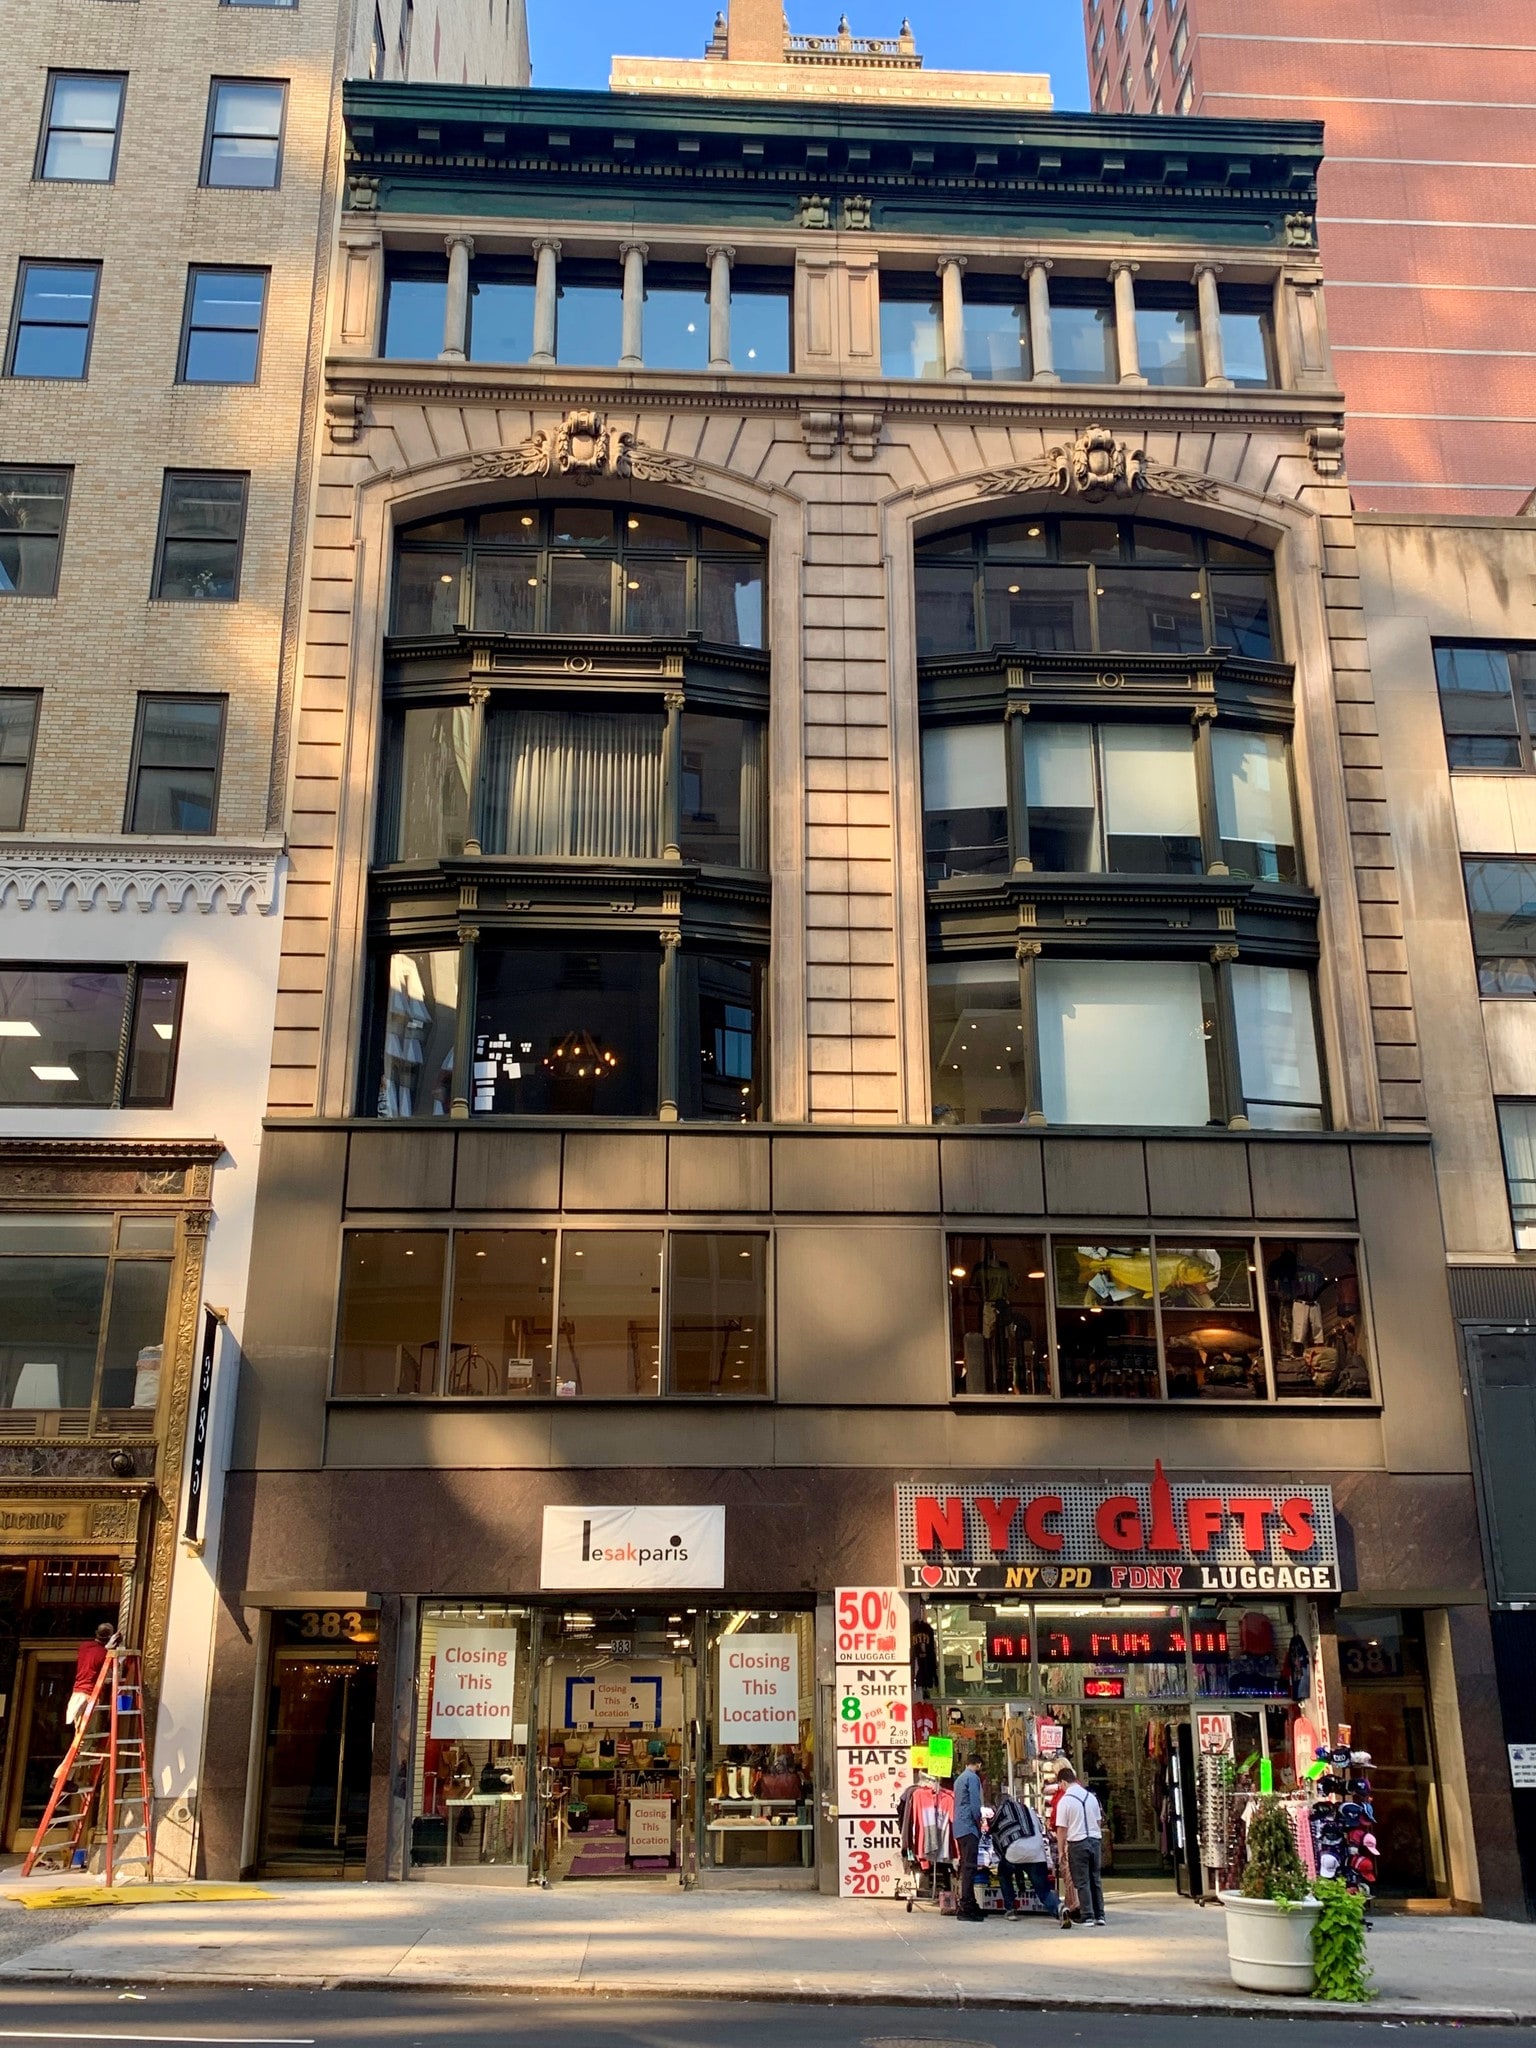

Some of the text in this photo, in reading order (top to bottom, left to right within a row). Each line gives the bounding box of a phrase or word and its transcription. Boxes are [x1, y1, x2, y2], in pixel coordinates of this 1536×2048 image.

[914, 1496, 1064, 1552] NYC
[582, 1519, 688, 1566] lesakparis
[1110, 1566, 1183, 1589] FDNY
[1201, 1566, 1332, 1590] LUGGAGE
[838, 1590, 897, 1631] 50%
[300, 1611, 362, 1638] 383
[611, 1641, 630, 1653] 383
[838, 1633, 877, 1651] OFF
[445, 1647, 508, 1667] Closing
[729, 1652, 790, 1672] Closing
[839, 1652, 896, 1661] ON LUGGAGE
[1346, 1649, 1398, 1673] 381
[457, 1673, 492, 1690] This
[857, 1669, 897, 1682] NY
[598, 1684, 627, 1694] Closing
[742, 1679, 777, 1696] This
[861, 1684, 908, 1696] SHIRT
[1086, 1682, 1121, 1696] OPEN
[436, 1701, 510, 1717] Location
[603, 1697, 620, 1705] This
[841, 1696, 883, 1721] 8 FOR
[594, 1709, 629, 1718] Location
[723, 1706, 797, 1722] Location
[889, 1737, 908, 1745] Each
[848, 1750, 907, 1766] HATS
[848, 1767, 887, 1787] 5 FOR
[635, 1809, 667, 1819] Closing
[642, 1823, 660, 1831] This
[631, 1836, 669, 1845] Location
[863, 1836, 901, 1849] SHIR
[848, 1851, 893, 1873] 3 FOR
